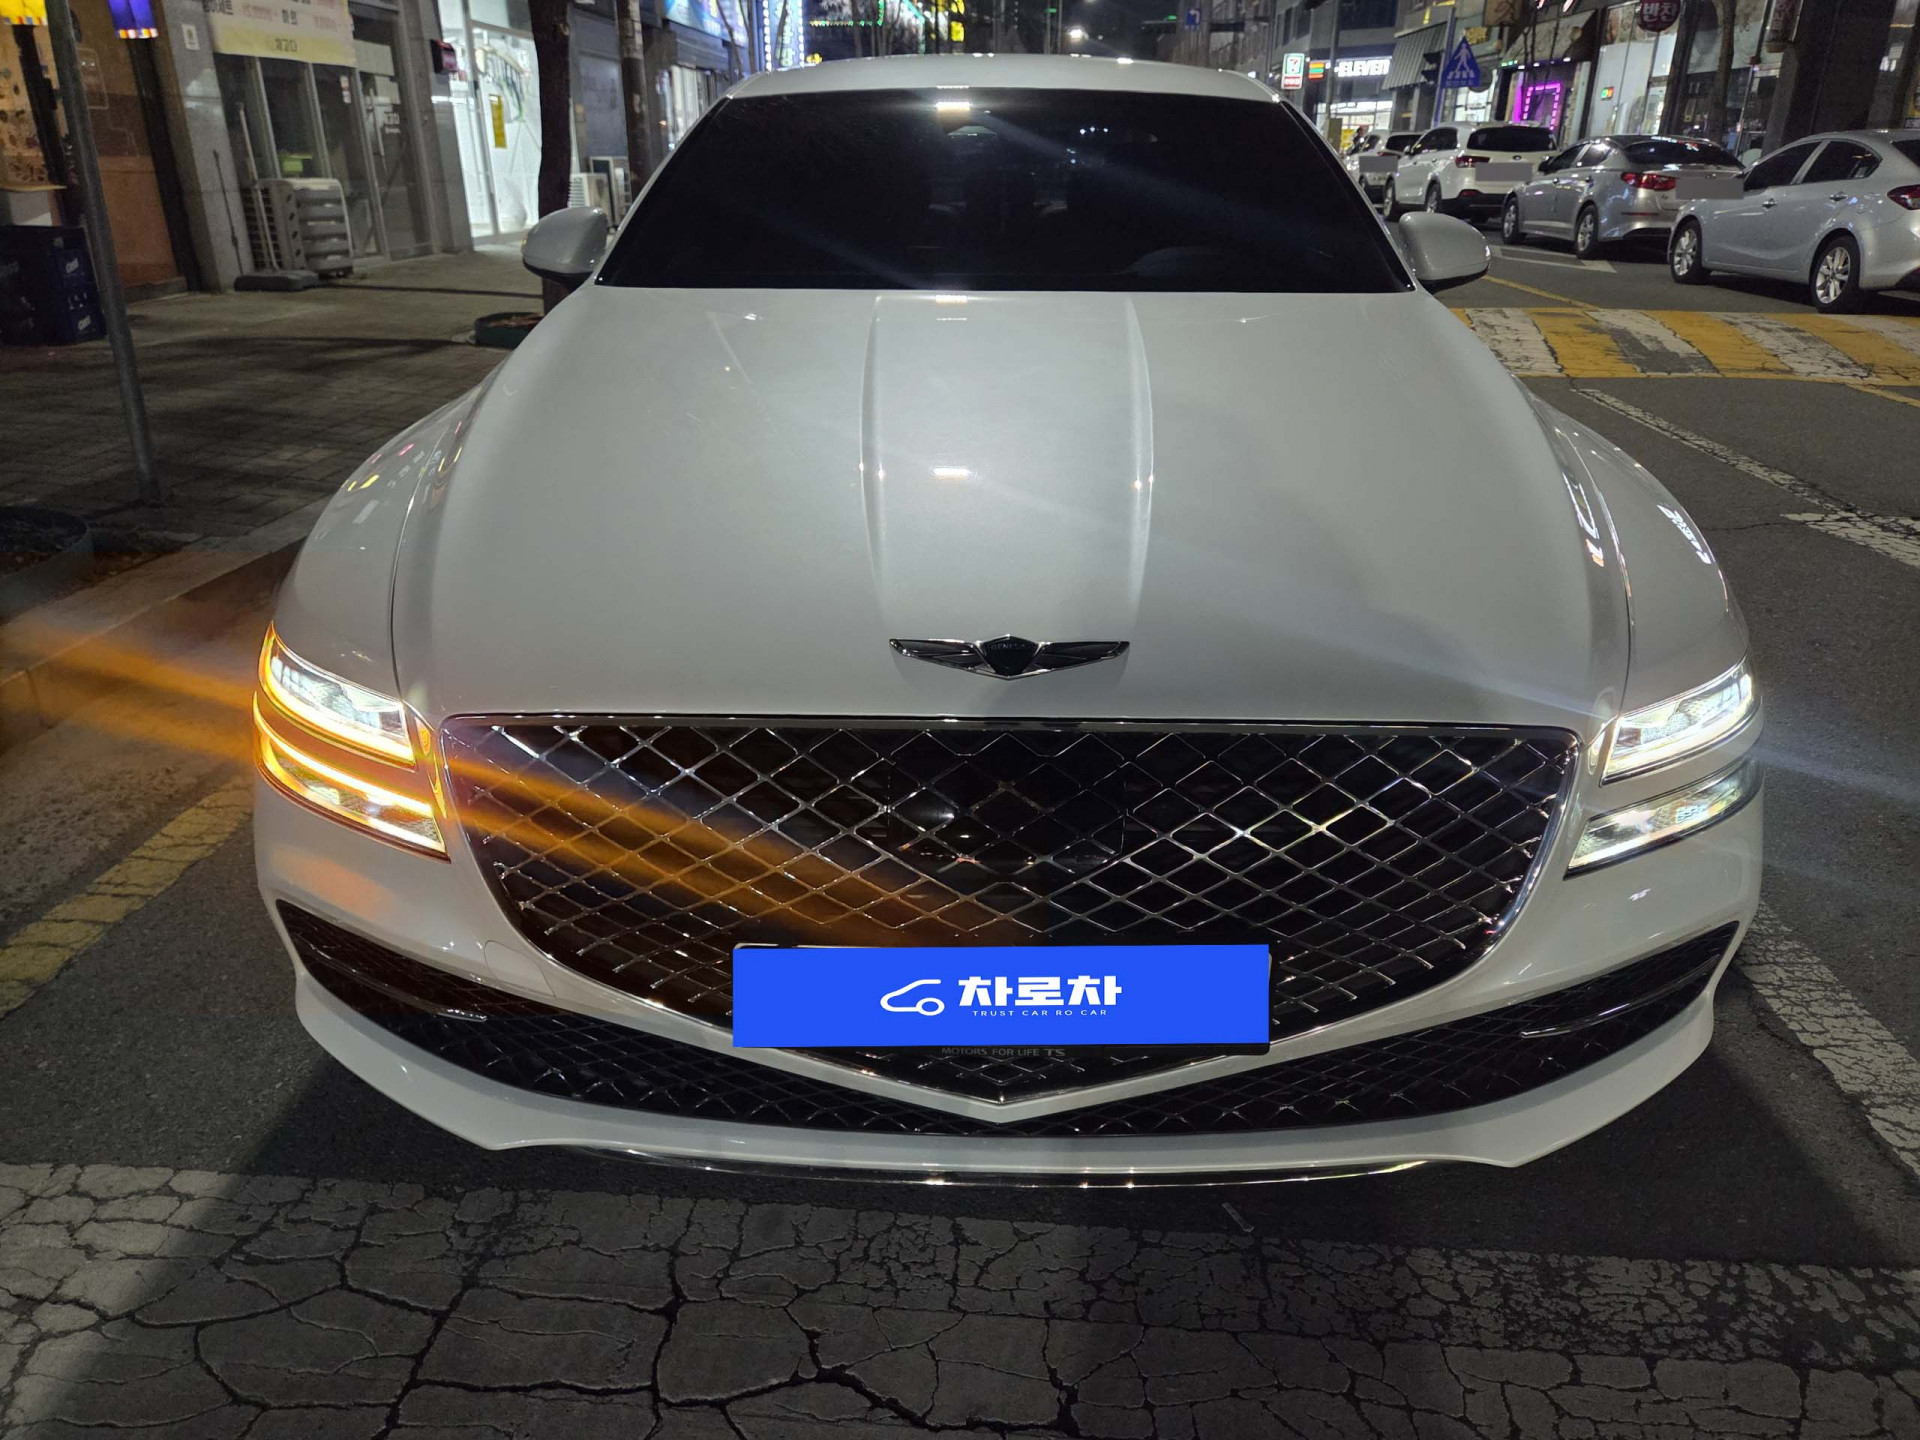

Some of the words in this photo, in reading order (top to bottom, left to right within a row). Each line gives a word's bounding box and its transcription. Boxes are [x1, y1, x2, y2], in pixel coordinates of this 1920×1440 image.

[1643, 1, 1679, 23] 반찬
[941, 1047, 987, 1056] MOTORS
[992, 1048, 1014, 1057] FOR
[1017, 1047, 1040, 1057] LIFE
[1043, 1048, 1066, 1057] TS
